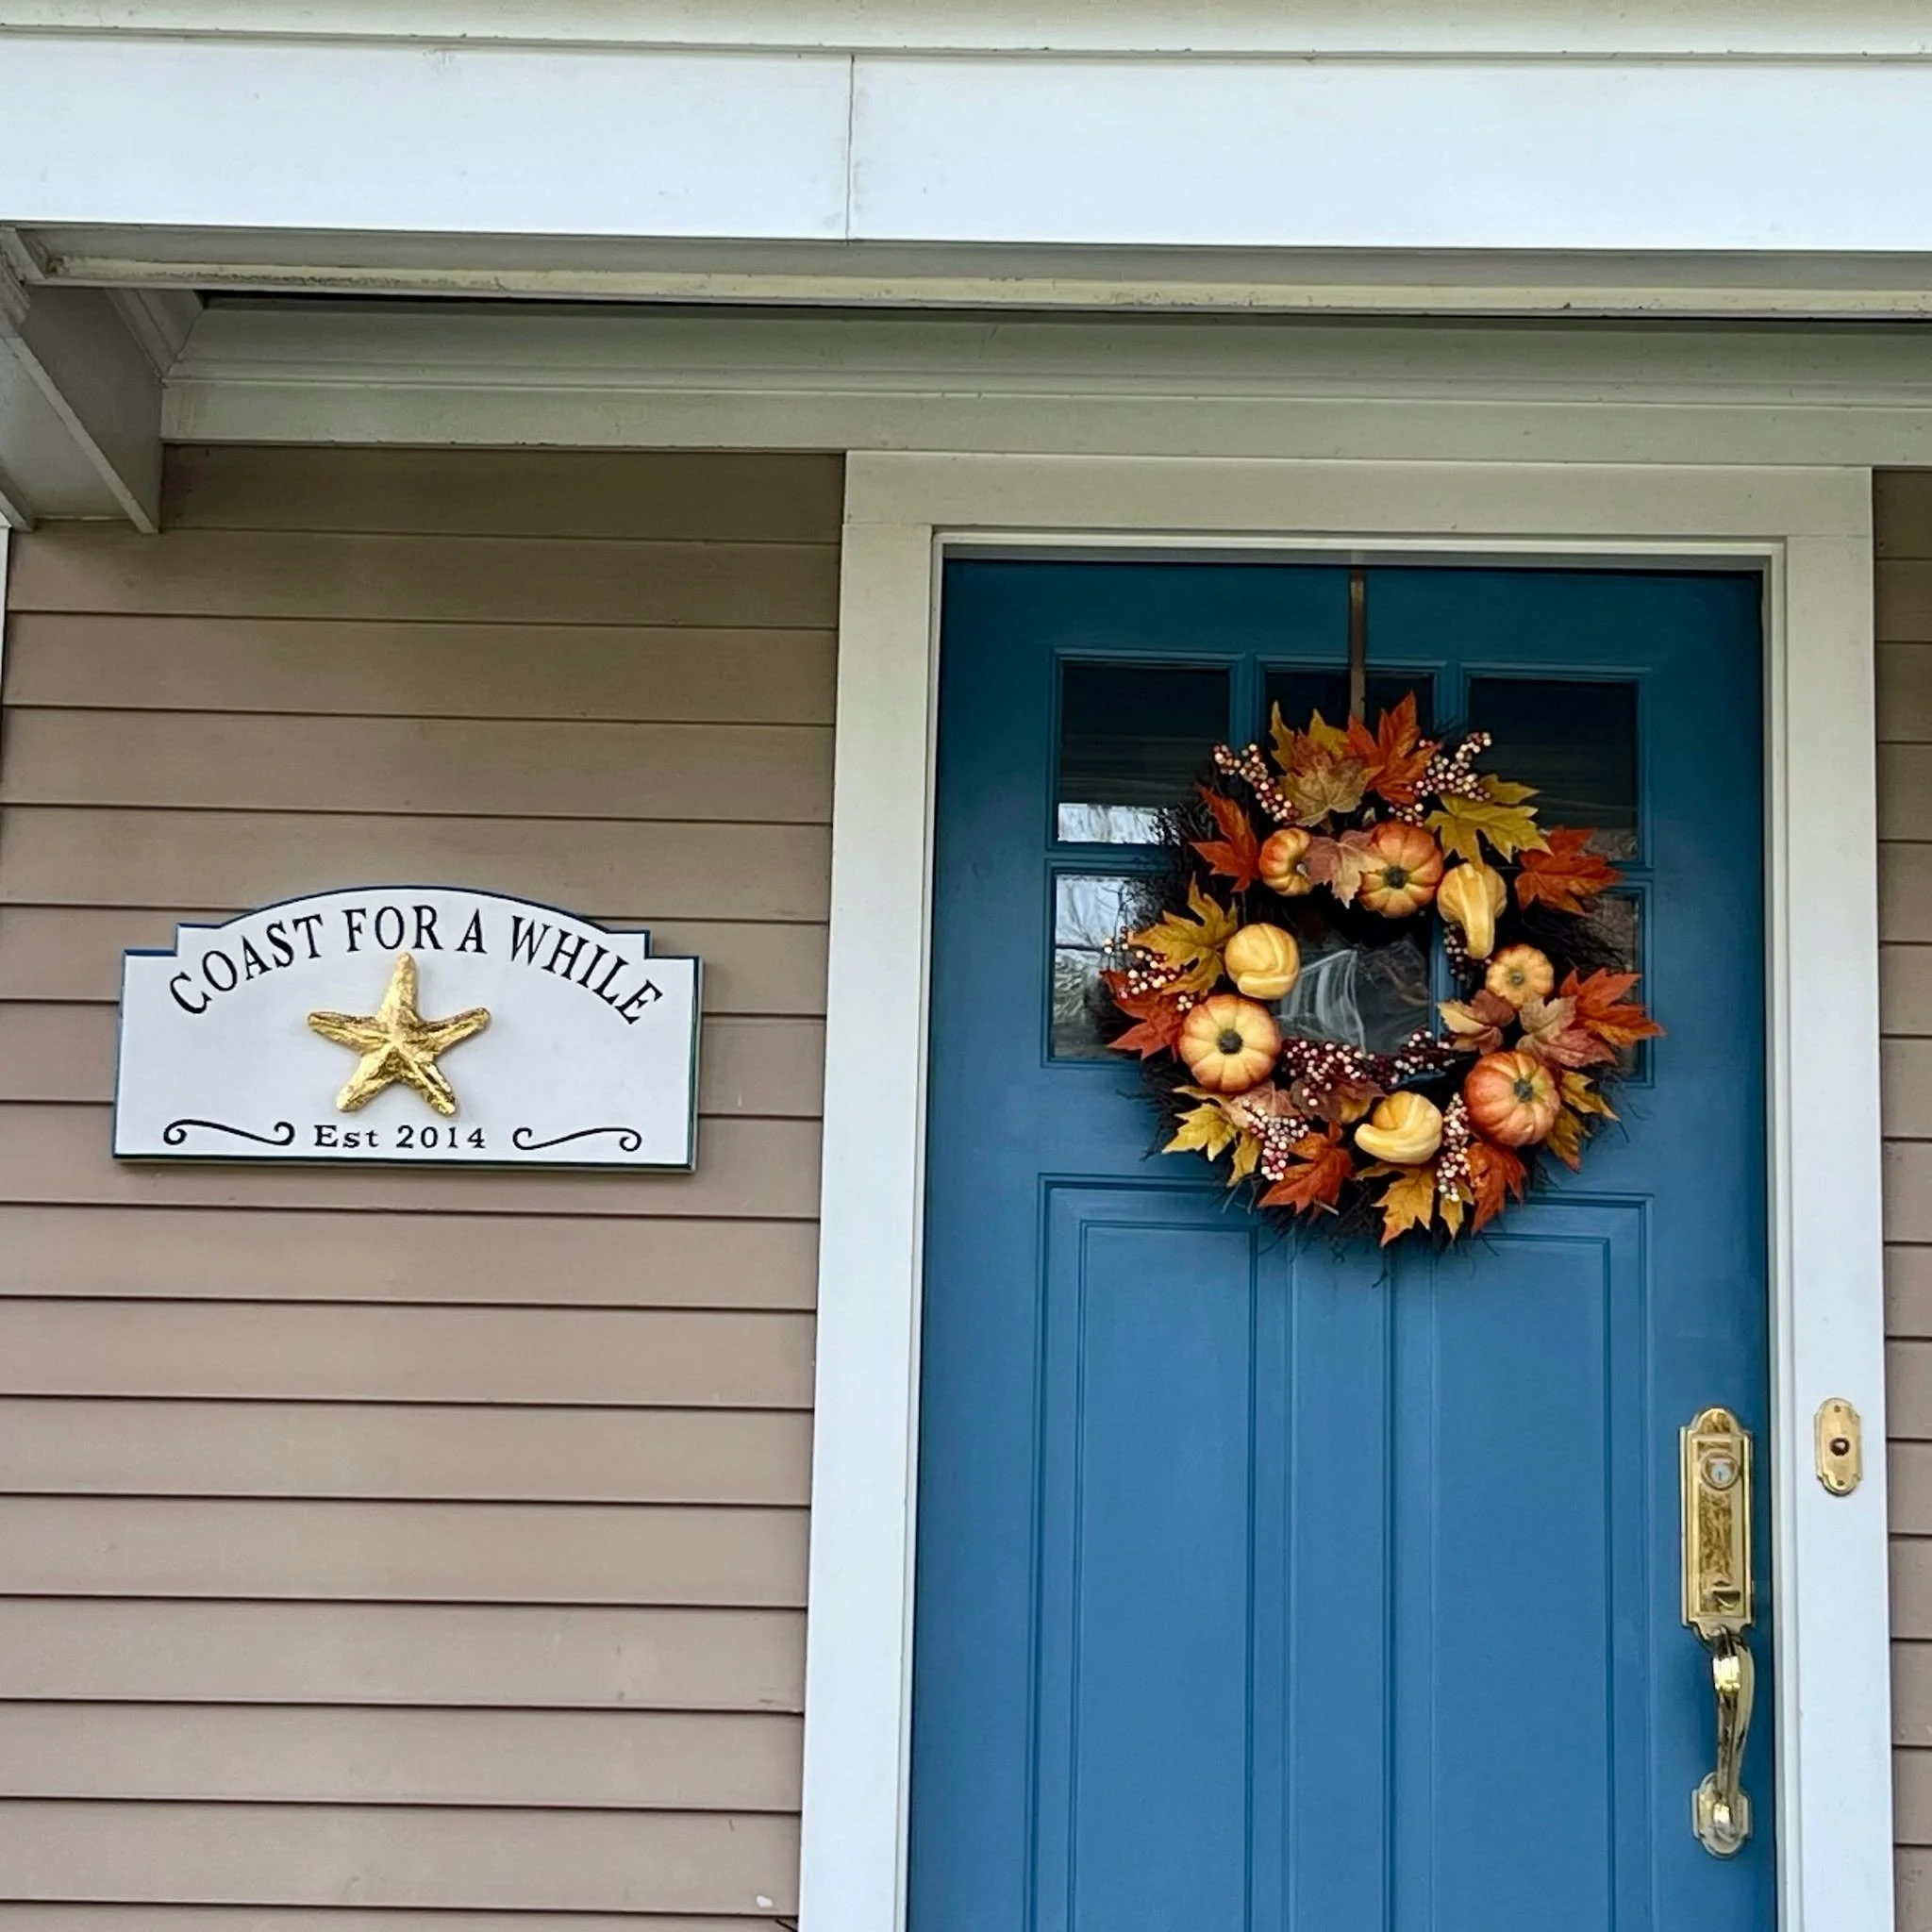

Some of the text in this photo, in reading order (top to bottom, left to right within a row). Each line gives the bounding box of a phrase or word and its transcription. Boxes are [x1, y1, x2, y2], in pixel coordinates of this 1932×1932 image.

[168, 905, 663, 1025] COAST FOR A WHILE
[313, 1124, 486, 1149] Est 2014
